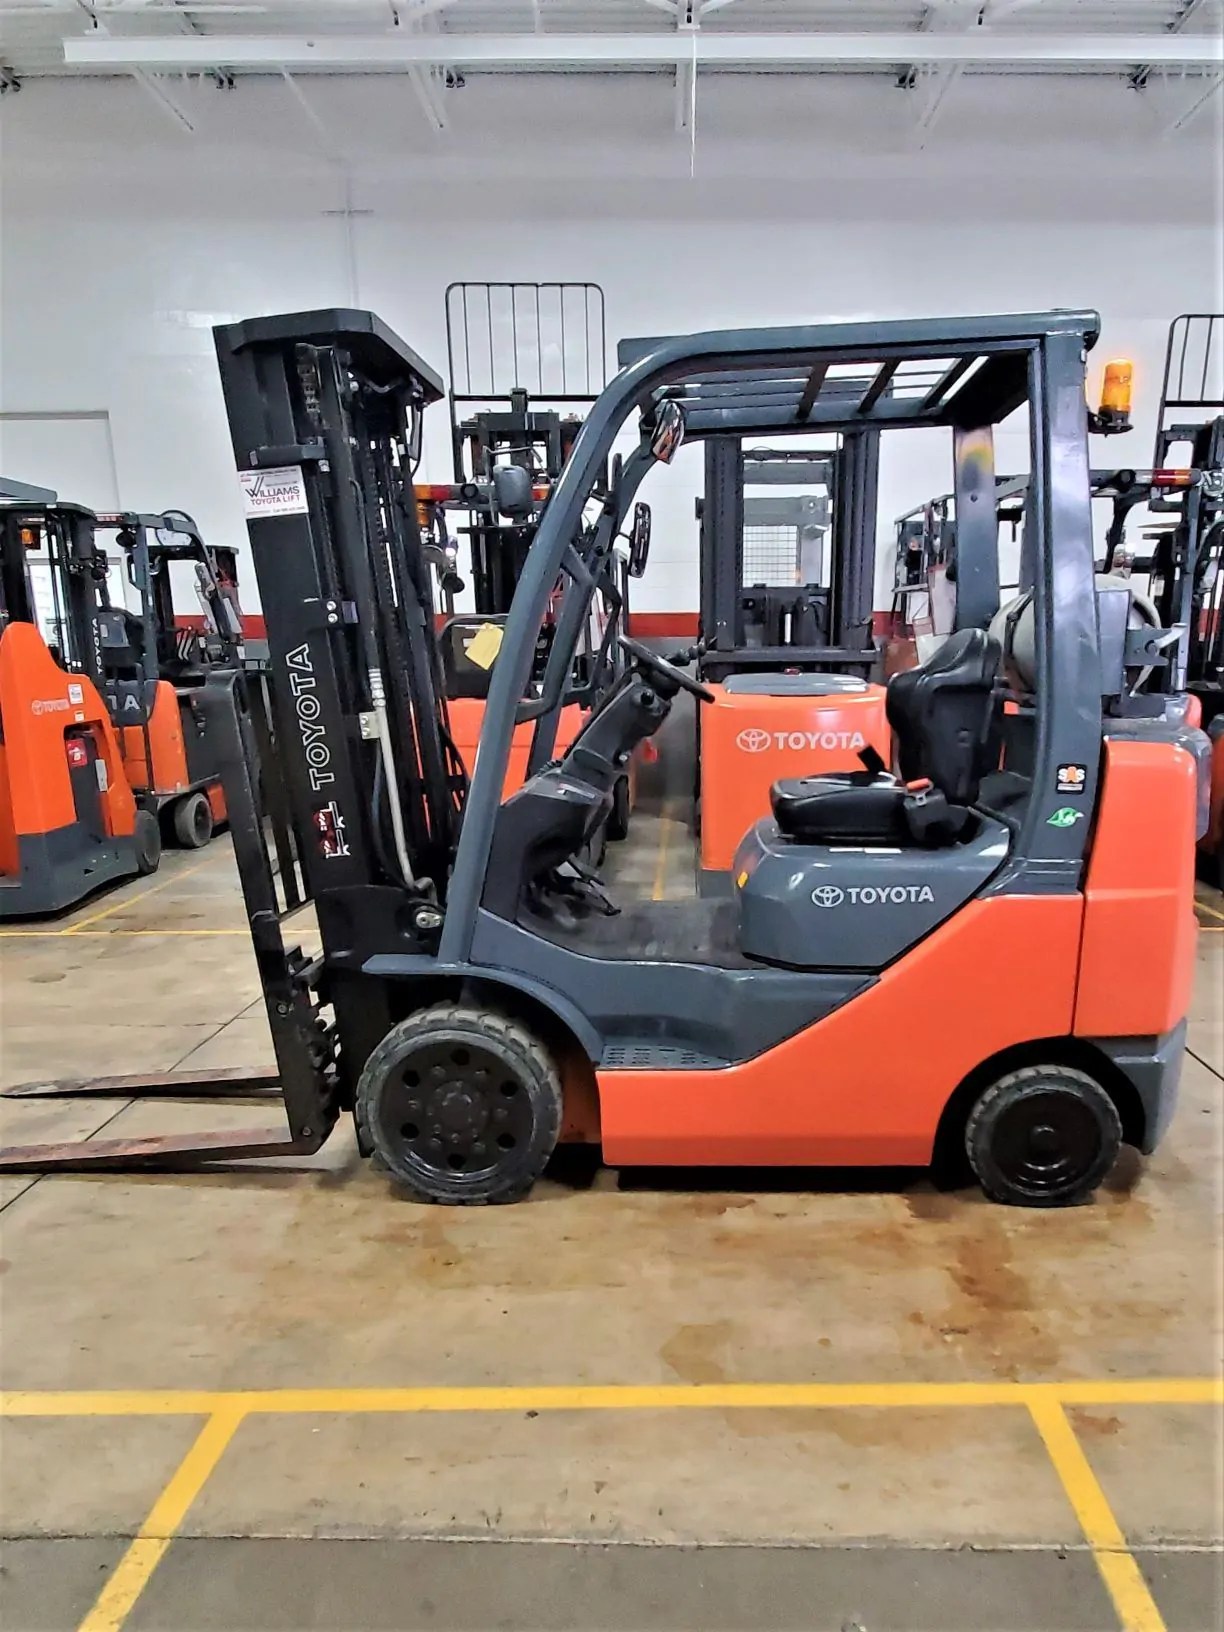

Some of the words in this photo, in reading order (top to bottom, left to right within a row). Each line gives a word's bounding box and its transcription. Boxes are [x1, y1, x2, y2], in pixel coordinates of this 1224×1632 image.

[245, 476, 300, 498] WILLIAMS
[251, 496, 281, 506] TOYOTA
[282, 495, 301, 503] LIFT
[92, 618, 103, 675] TOYOTA
[286, 643, 335, 791] TOYOTA
[774, 731, 866, 750] TOYOTA
[847, 885, 935, 904] TOYOTA
